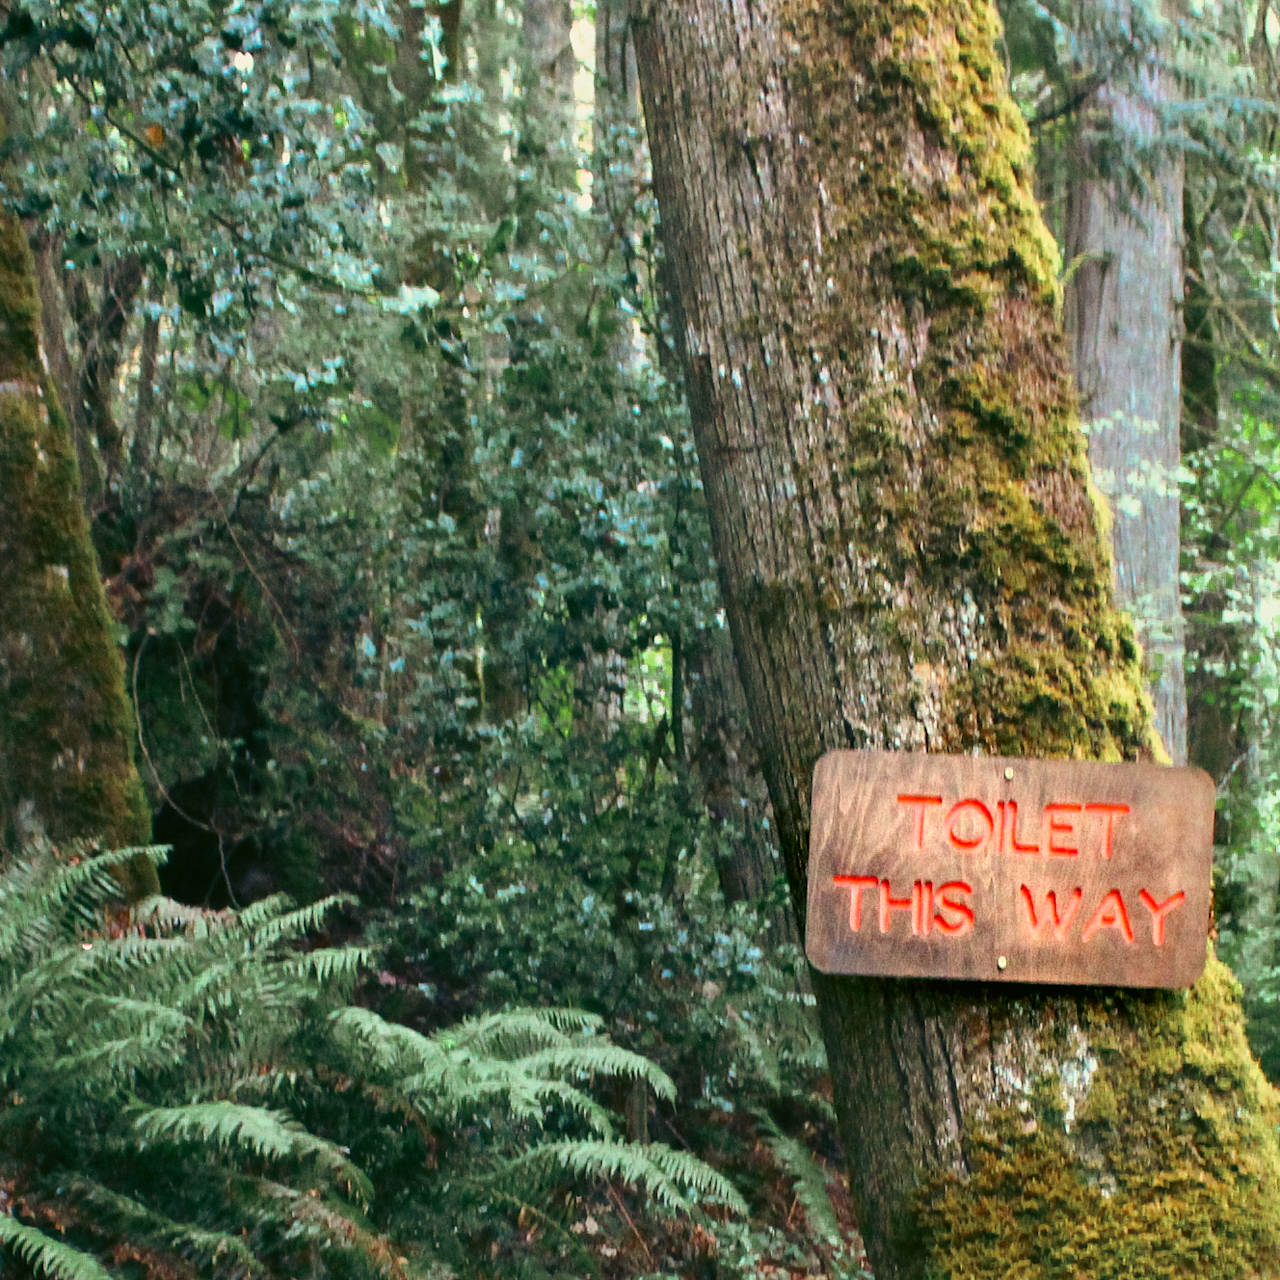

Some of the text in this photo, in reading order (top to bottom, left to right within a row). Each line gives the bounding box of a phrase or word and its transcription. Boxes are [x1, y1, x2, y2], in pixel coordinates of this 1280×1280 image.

[897, 794, 1130, 858] TOILET
[833, 875, 1185, 946] THIS WAY
